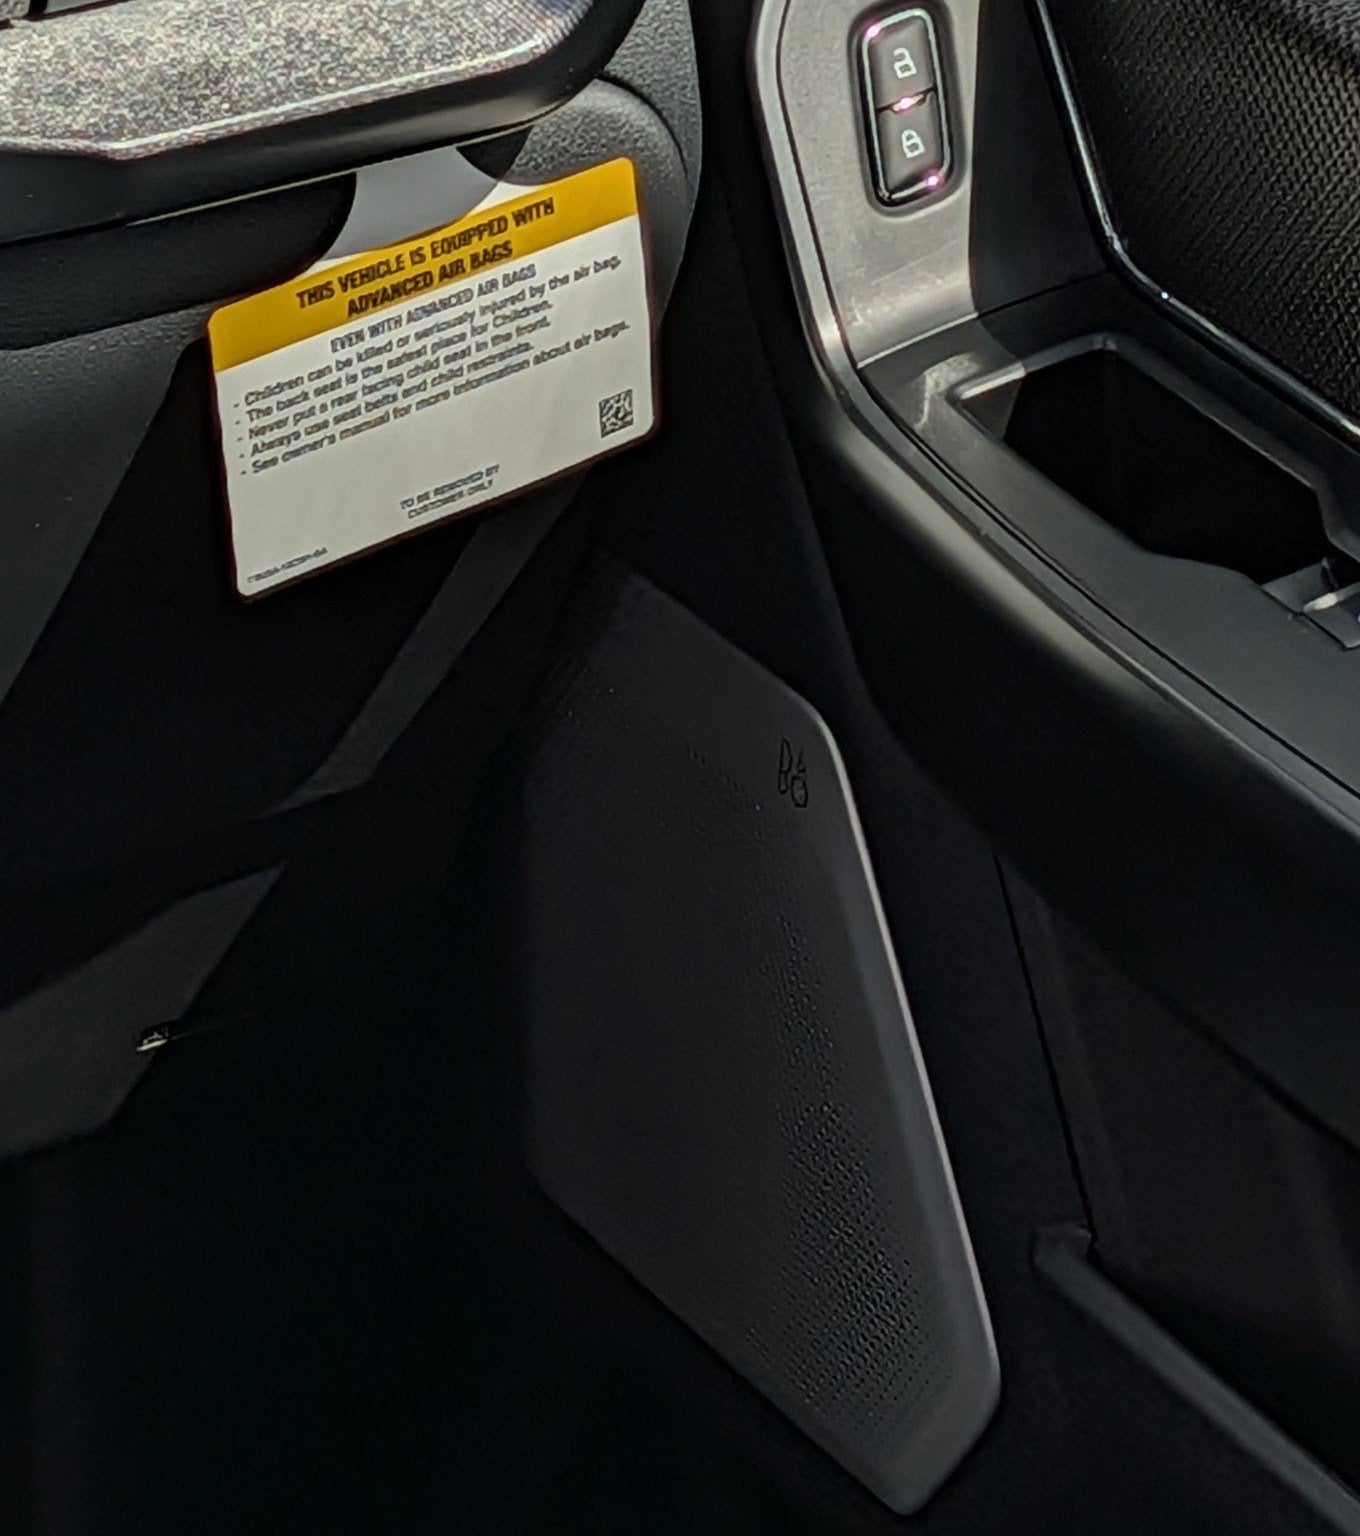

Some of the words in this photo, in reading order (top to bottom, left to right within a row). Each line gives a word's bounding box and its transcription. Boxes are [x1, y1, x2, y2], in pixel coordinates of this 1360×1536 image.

[296, 280, 334, 308] THIS
[337, 254, 404, 292] VEHICLE
[408, 246, 426, 266] IS
[430, 215, 507, 258] EQUIPPED
[512, 197, 554, 226] WITH
[347, 271, 433, 317] ADVANCED
[438, 258, 465, 282] AIR
[470, 240, 512, 269] BAGS
[244, 376, 304, 405] Children
[307, 365, 332, 382] can
[335, 357, 353, 371] be
[356, 339, 393, 362] killed
[396, 334, 410, 348] or
[479, 288, 525, 316] injured
[528, 283, 545, 298] by
[548, 274, 569, 290] the
[573, 266, 590, 281] air
[330, 328, 364, 352] EVEN
[367, 314, 402, 338] WITH
[477, 278, 498, 297] AIR
[502, 263, 536, 287] BAGS
[245, 405, 273, 422] The
[275, 390, 309, 411] back
[313, 376, 342, 397] seat
[345, 372, 358, 385] is
[360, 364, 383, 379] the
[430, 332, 466, 354] place
[470, 322, 489, 337] for
[248, 416, 289, 439] Never
[292, 405, 315, 426] put
[318, 402, 328, 414] a
[330, 390, 357, 408] rear
[406, 356, 440, 378] child
[443, 345, 471, 364] seat
[475, 340, 488, 352] in
[490, 332, 512, 347] the
[250, 430, 301, 456] Always
[332, 404, 361, 425] seat
[401, 378, 427, 398] and
[430, 365, 463, 387] child
[251, 456, 278, 473] See
[392, 403, 411, 419] for
[532, 341, 570, 365] about
[573, 334, 590, 349] air
